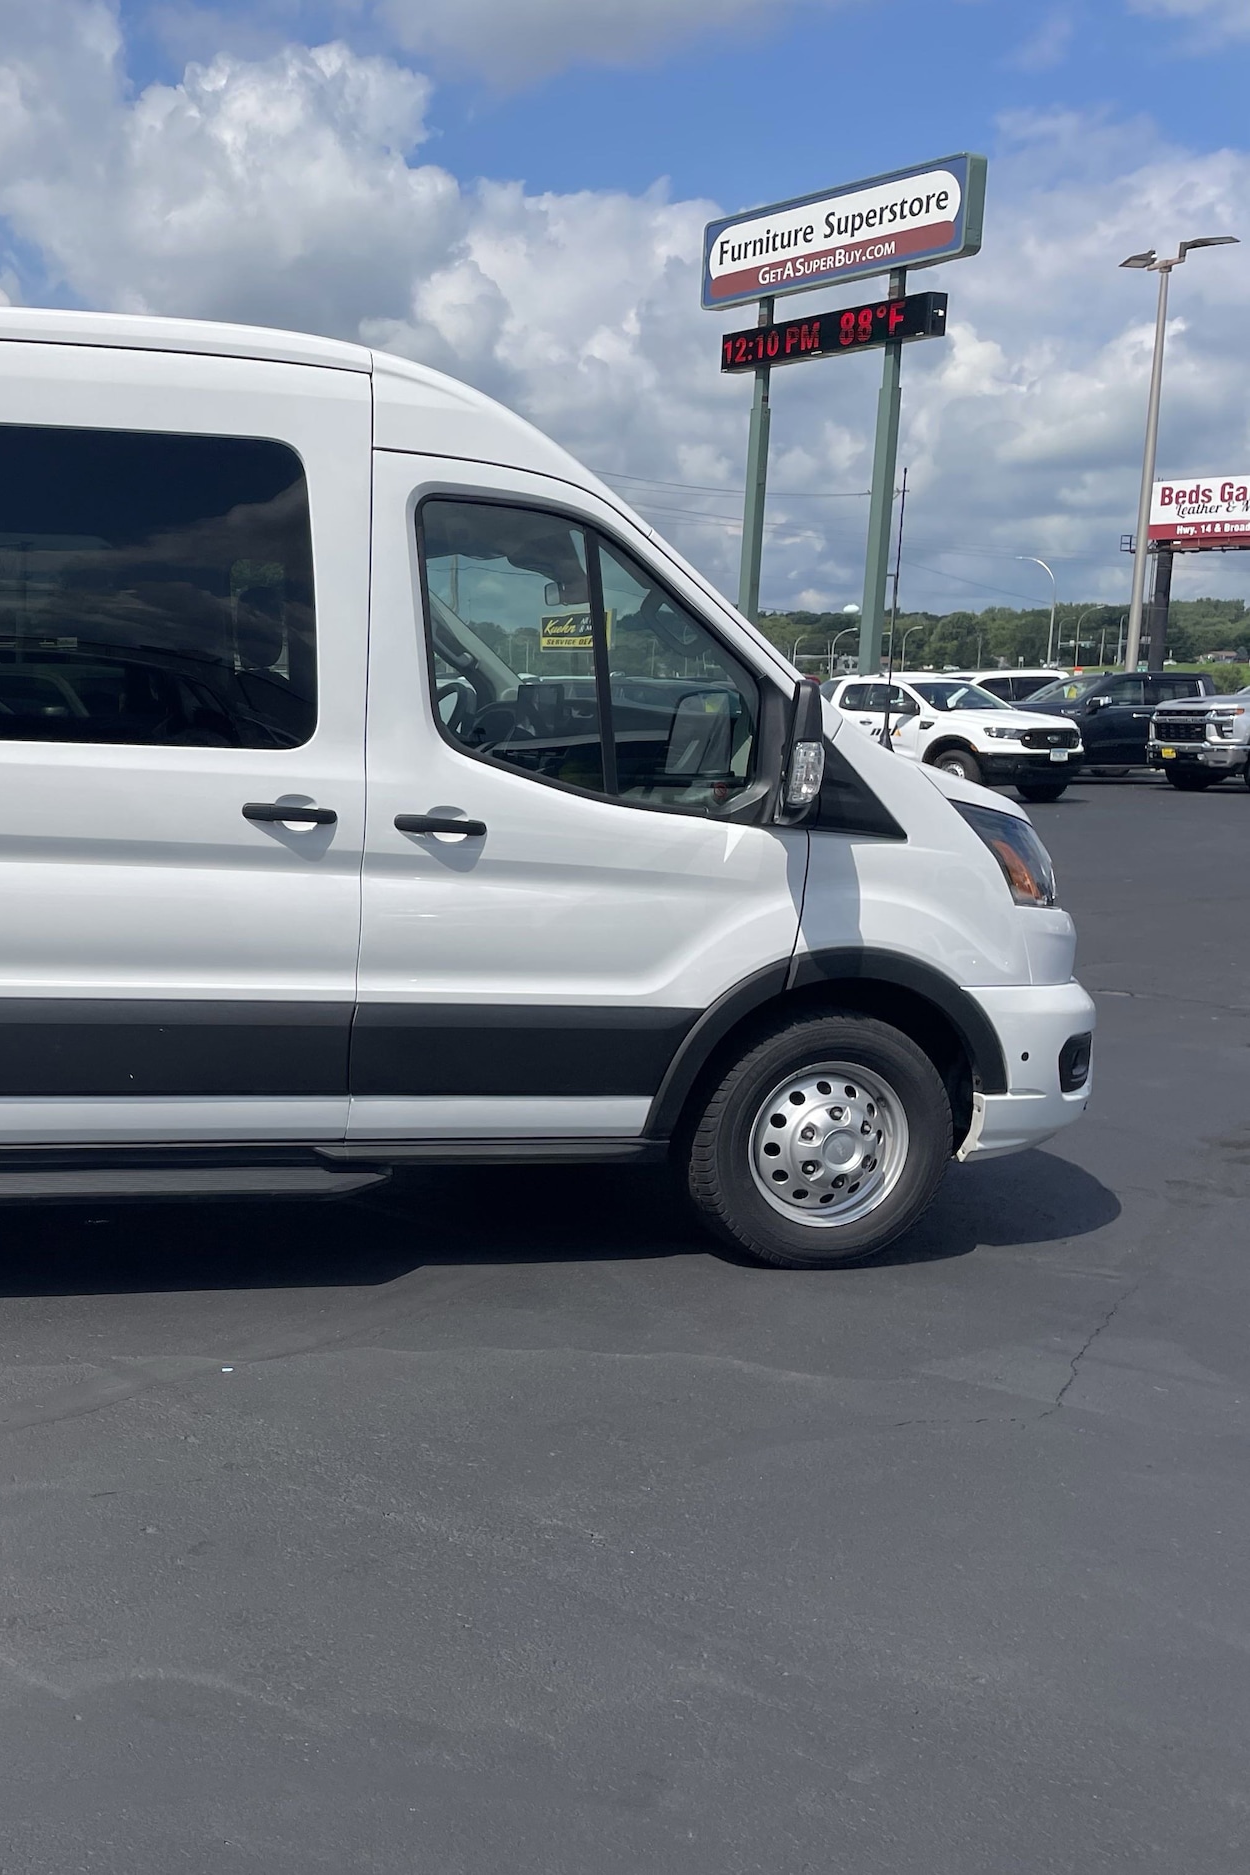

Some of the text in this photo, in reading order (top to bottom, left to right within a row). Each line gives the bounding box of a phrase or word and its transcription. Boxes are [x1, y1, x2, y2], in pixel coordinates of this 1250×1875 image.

[718, 189, 949, 266] Furniture Superstore
[724, 331, 779, 364] 12:10
[786, 321, 821, 353] PM
[1160, 484, 1213, 507] Beds
[1176, 500, 1223, 519] Leather
[1226, 500, 1237, 513] &
[1176, 525, 1198, 536] Hwy.
[1200, 523, 1212, 534] 14
[1214, 523, 1222, 533] &
[543, 617, 577, 635] Kuehn
